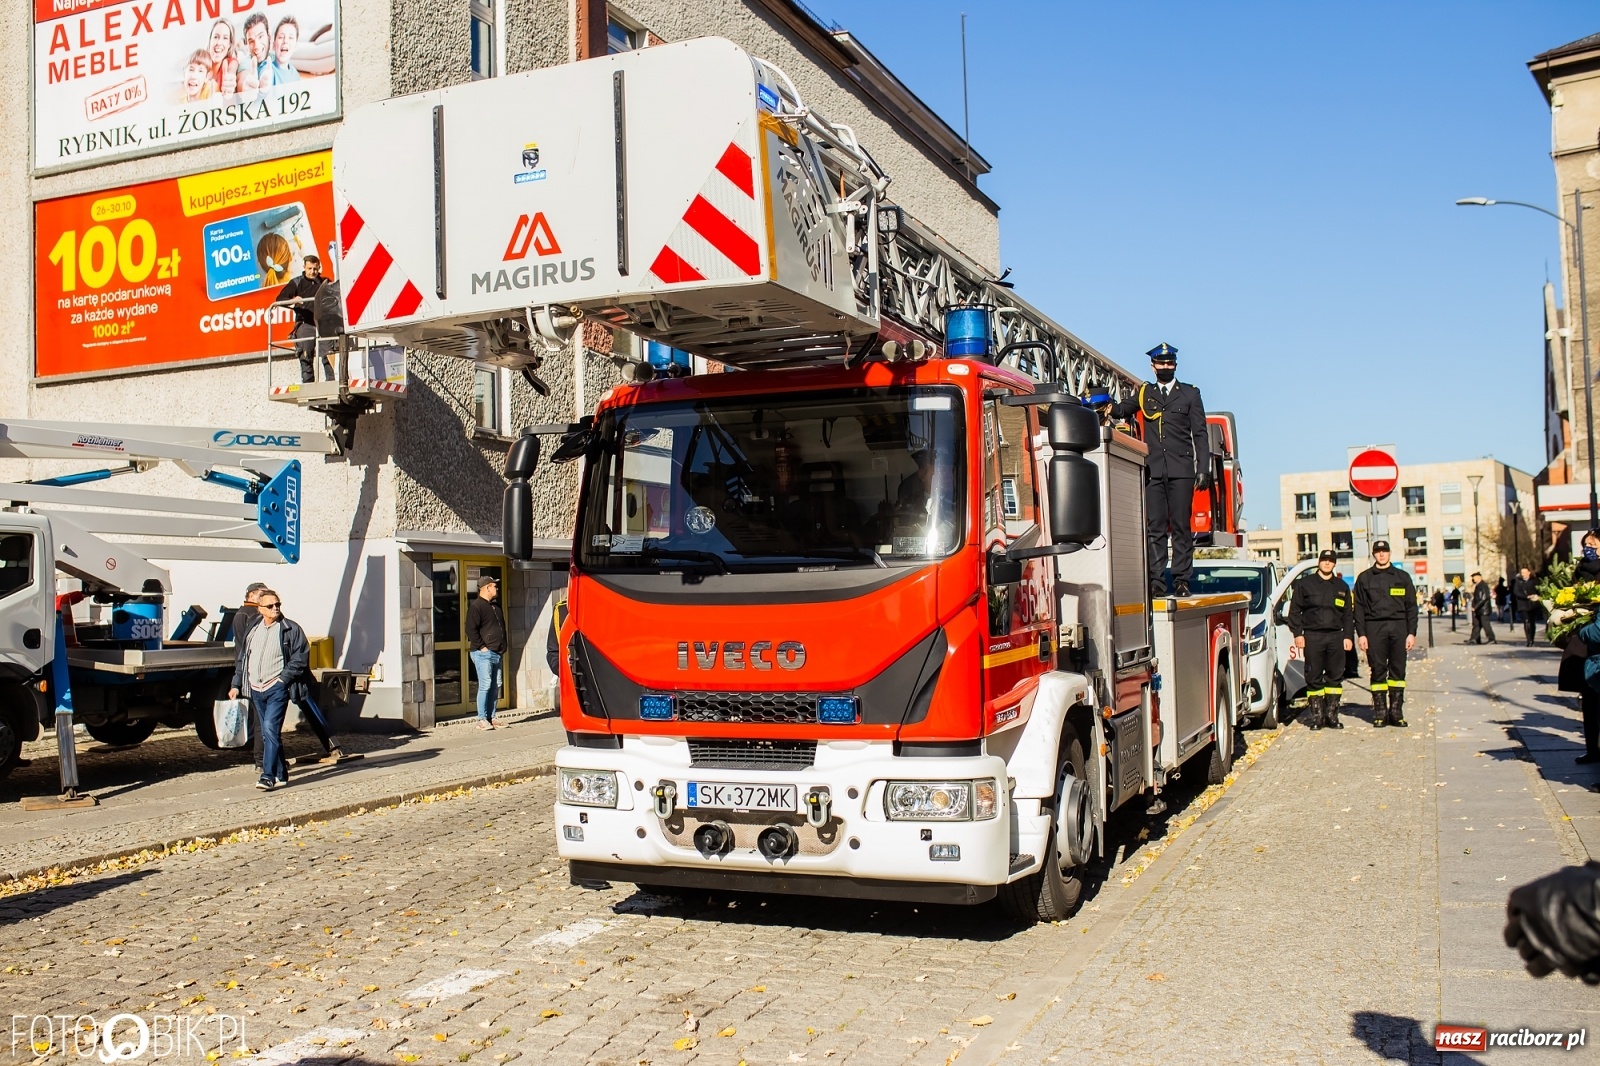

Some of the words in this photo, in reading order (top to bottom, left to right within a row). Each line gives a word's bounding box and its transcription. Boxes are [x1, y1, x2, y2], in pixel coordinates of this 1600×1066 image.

[49, 0, 286, 55] ALEXAN
[48, 43, 138, 85] MEBLE
[91, 91, 121, 115] RATY
[124, 84, 142, 101] 0%
[58, 124, 142, 158] RYBNIK,
[148, 117, 172, 140] ul.
[178, 98, 271, 134] ŻORSKA
[277, 90, 312, 116] 192
[189, 184, 252, 210] kupujesz,
[254, 161, 326, 195] zyskujesz!
[96, 201, 132, 216] 26-30.10
[776, 166, 820, 283] MAGIRUS
[214, 273, 255, 290] castorama
[471, 257, 596, 295] MAGIRUS
[57, 298, 71, 309] na
[72, 293, 98, 307] kartę
[100, 283, 172, 306] podarunkową
[70, 313, 83, 324] za
[84, 308, 115, 323] każde
[116, 302, 159, 320] wydane
[199, 306, 297, 333] castoram
[92, 322, 119, 339] 1000
[212, 430, 301, 447] SOCAGE
[676, 640, 808, 672] IVECO
[700, 785, 726, 806] SK
[733, 787, 791, 808] 372MK
